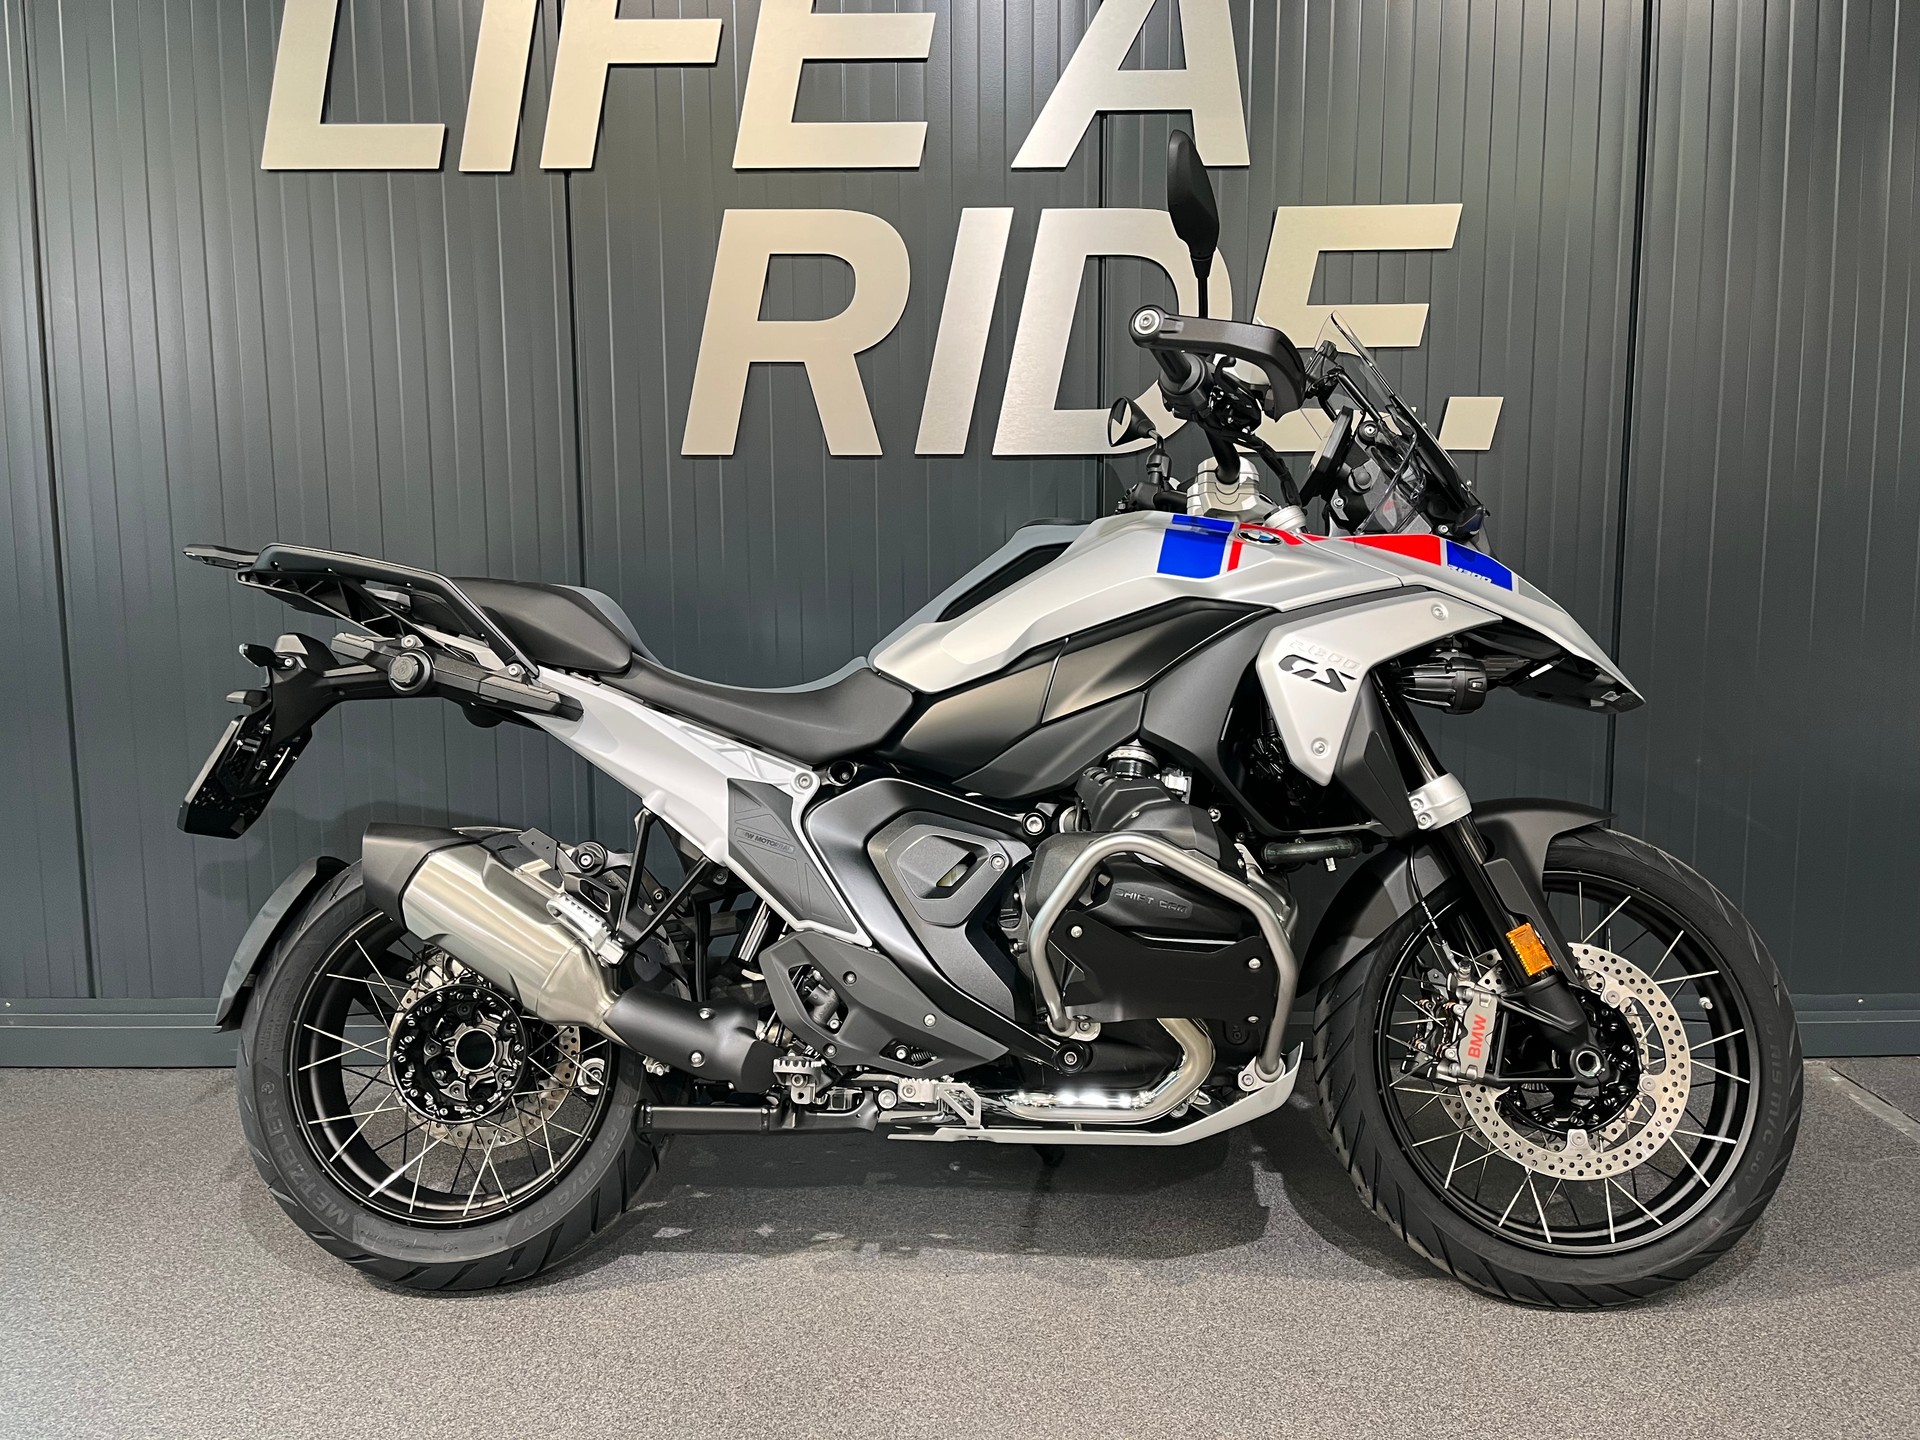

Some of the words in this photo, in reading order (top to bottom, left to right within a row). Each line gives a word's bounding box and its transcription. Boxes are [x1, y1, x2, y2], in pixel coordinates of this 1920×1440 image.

[261, 0, 936, 172] LIFE
[1010, 0, 1251, 169] A
[681, 203, 1504, 457] RIDE.
[1278, 653, 1357, 693] GS
[1115, 887, 1155, 905] SHIFT
[1467, 1014, 1487, 1059] BMW
[262, 1098, 350, 1227] METZELER
